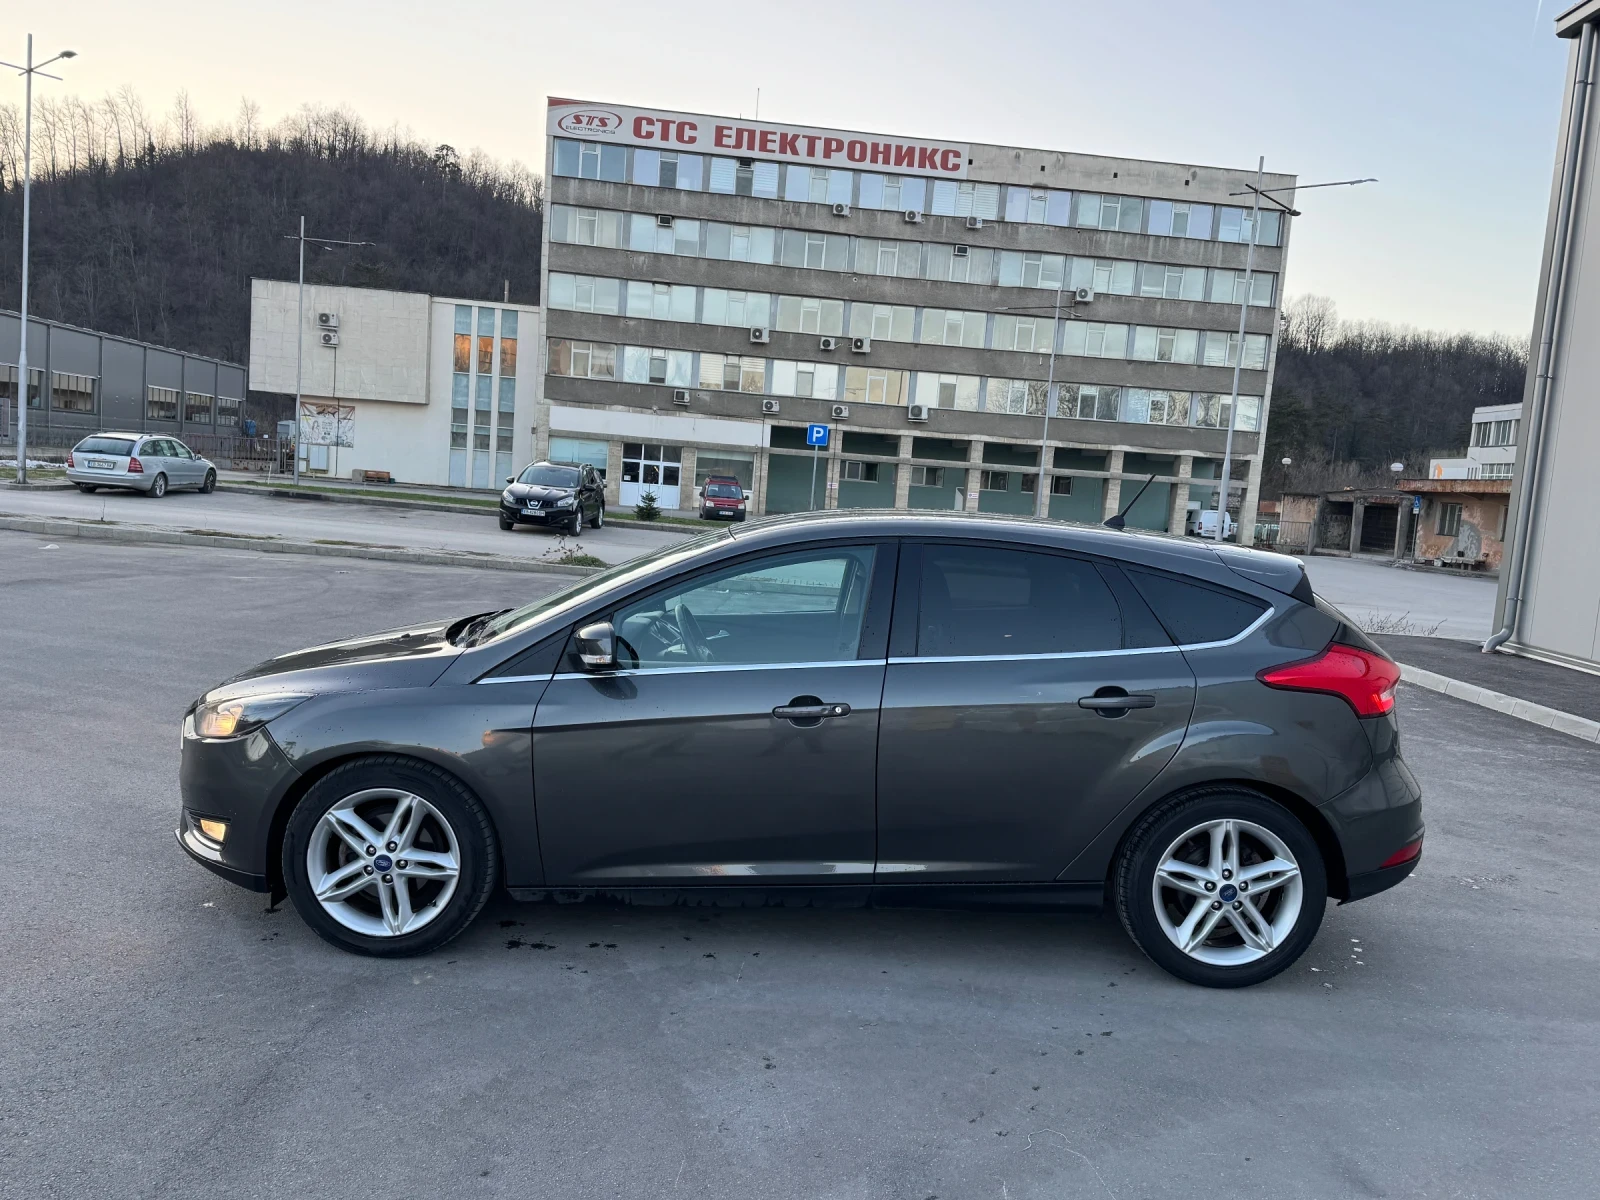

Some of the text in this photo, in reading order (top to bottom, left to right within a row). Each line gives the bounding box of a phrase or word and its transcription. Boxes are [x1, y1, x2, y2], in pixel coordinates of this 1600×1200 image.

[571, 114, 611, 128] STS
[565, 124, 616, 135] ELECTRONICS
[632, 115, 962, 172] СТС ЕЛЕКТРОНИКС
[812, 426, 825, 442] P
